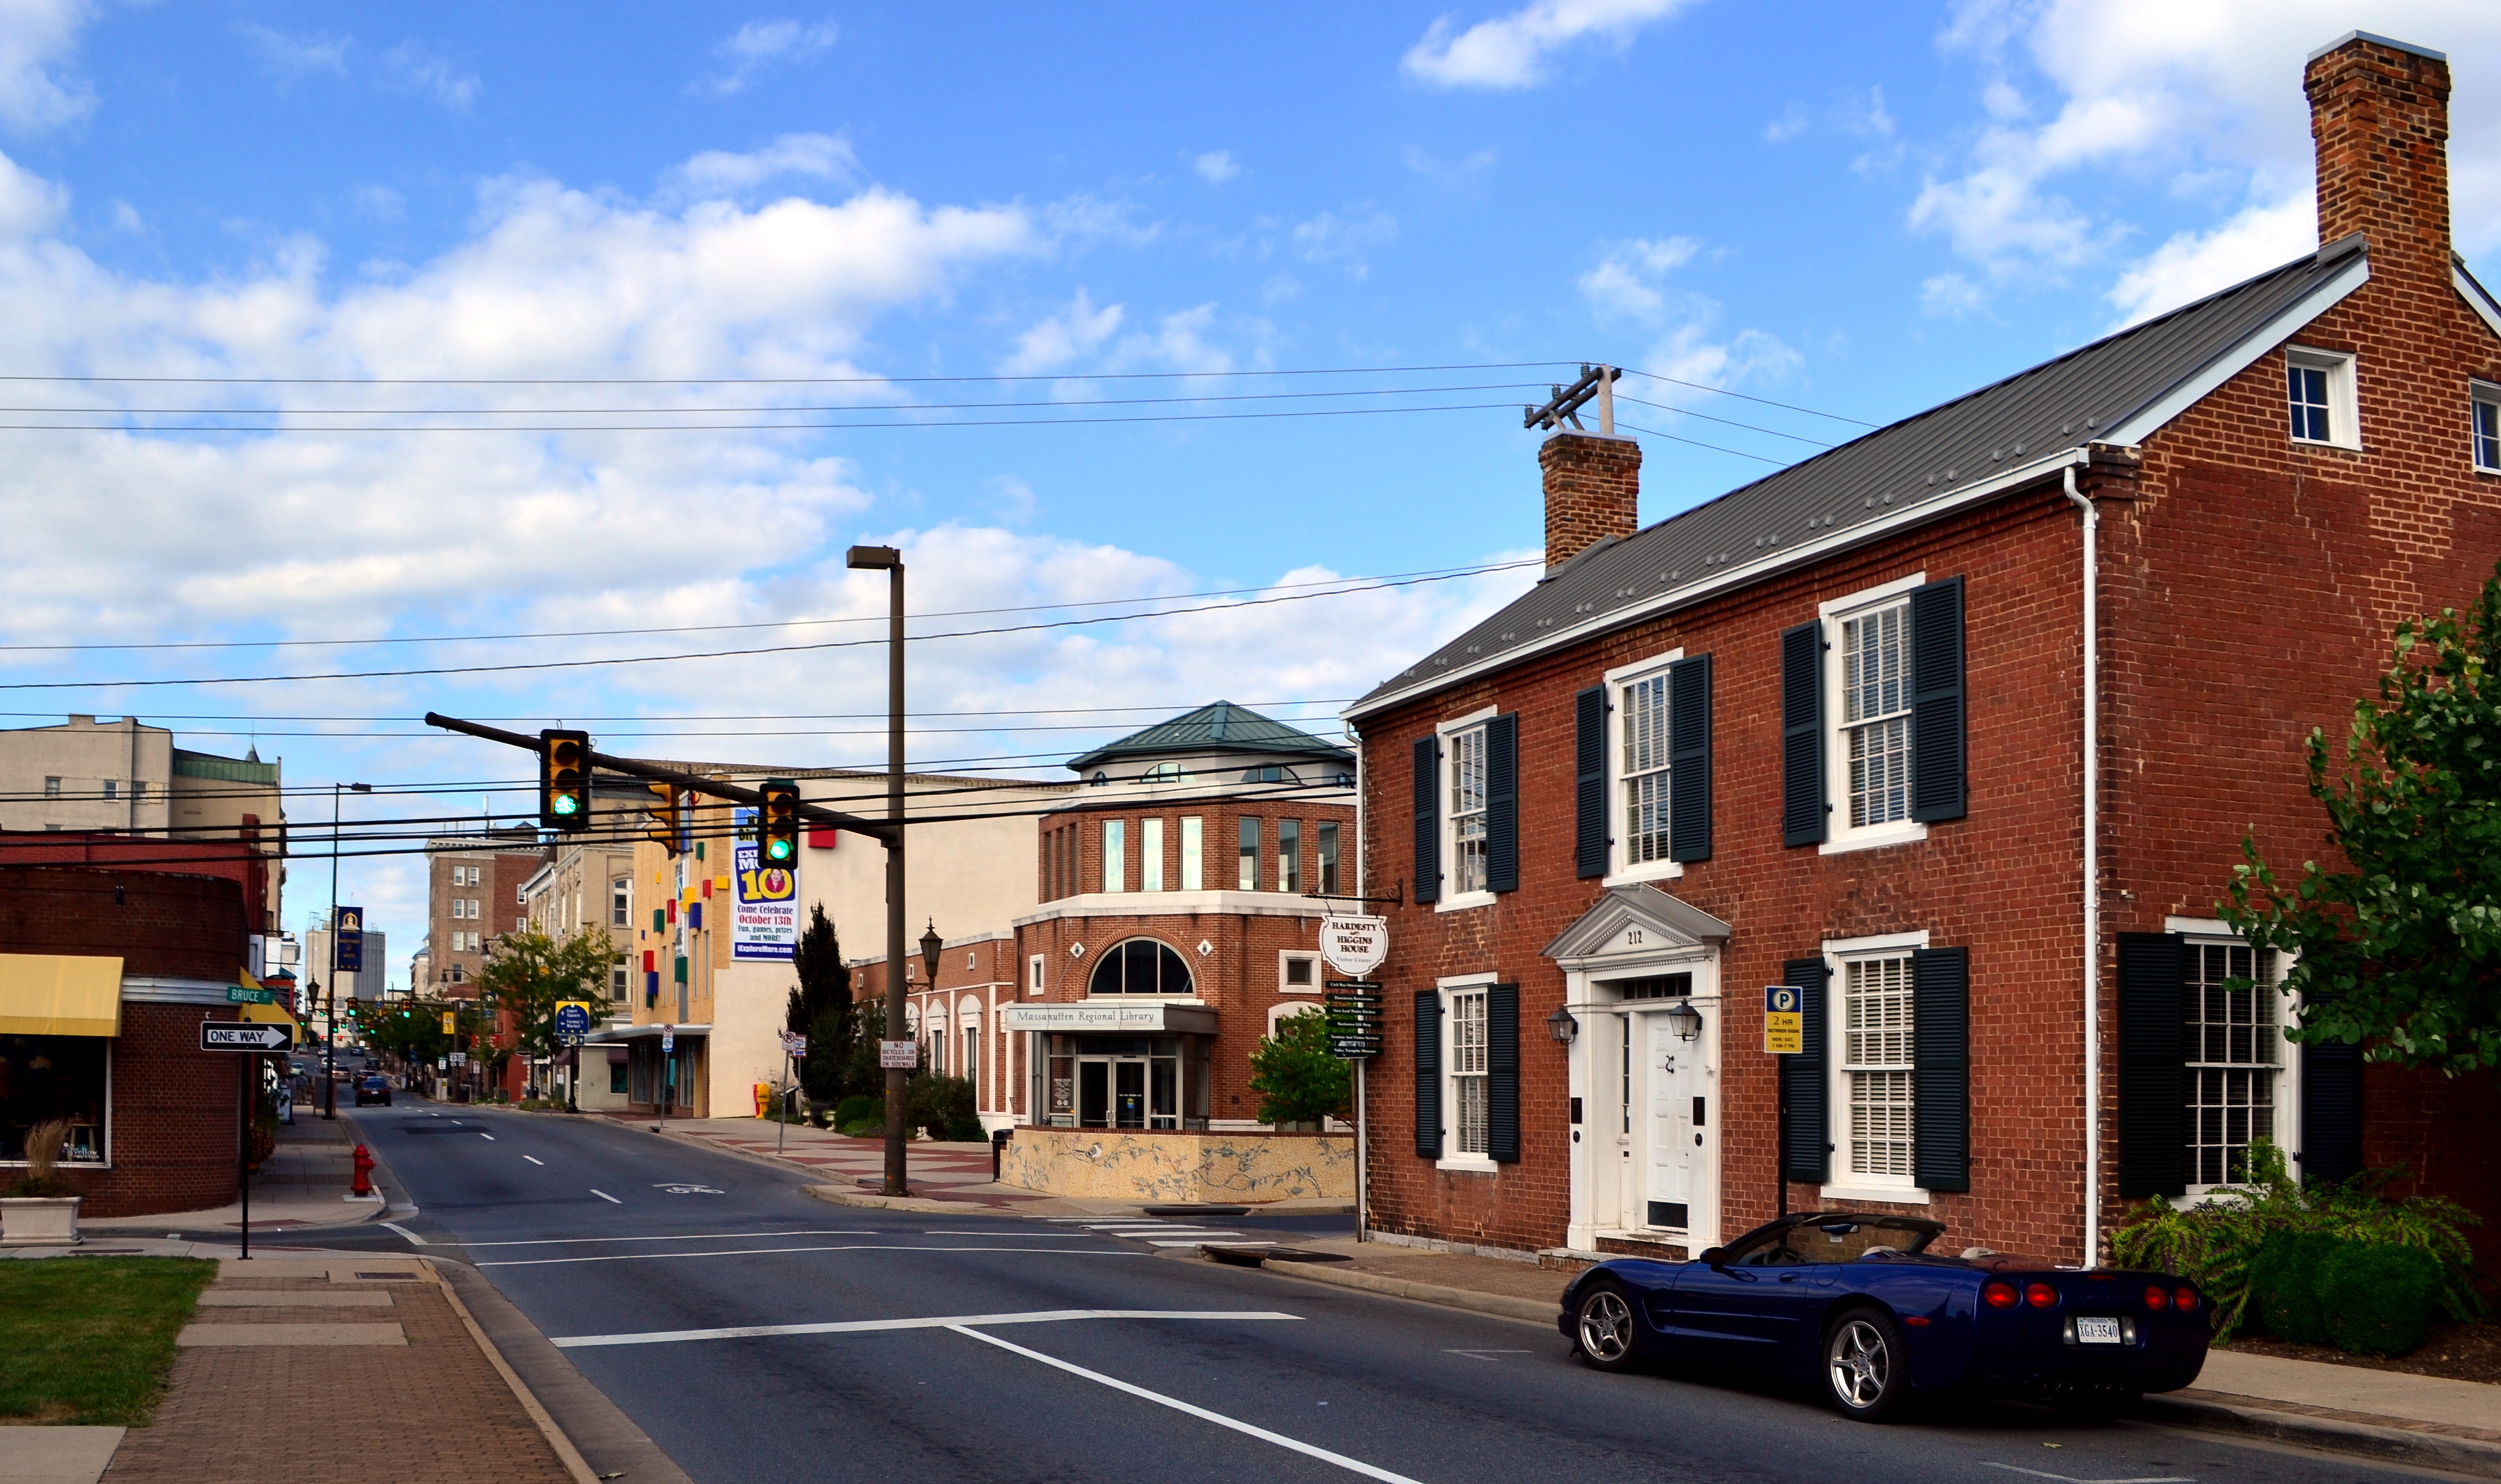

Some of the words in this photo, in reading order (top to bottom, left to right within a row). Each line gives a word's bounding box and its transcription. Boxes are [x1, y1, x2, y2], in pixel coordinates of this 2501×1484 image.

[741, 868, 792, 900] 10
[737, 904, 757, 913] Come
[760, 906, 793, 915] Celebrate
[739, 915, 771, 925] October
[775, 916, 792, 925] 13th
[1332, 922, 1377, 931] HARDESTY
[1337, 936, 1373, 944] HIGGINS
[1628, 930, 1642, 945] 212
[231, 989, 259, 1002] BRUCE
[1779, 993, 1789, 1007] P
[1017, 1011, 1074, 1021] Massanutten
[1079, 1011, 1116, 1022] Regional
[1121, 1011, 1154, 1022] Library
[1773, 1016, 1779, 1025] 2
[210, 1031, 234, 1042] ONE
[239, 1031, 265, 1042] WAY
[2079, 1323, 2118, 1337] XGA-3540
